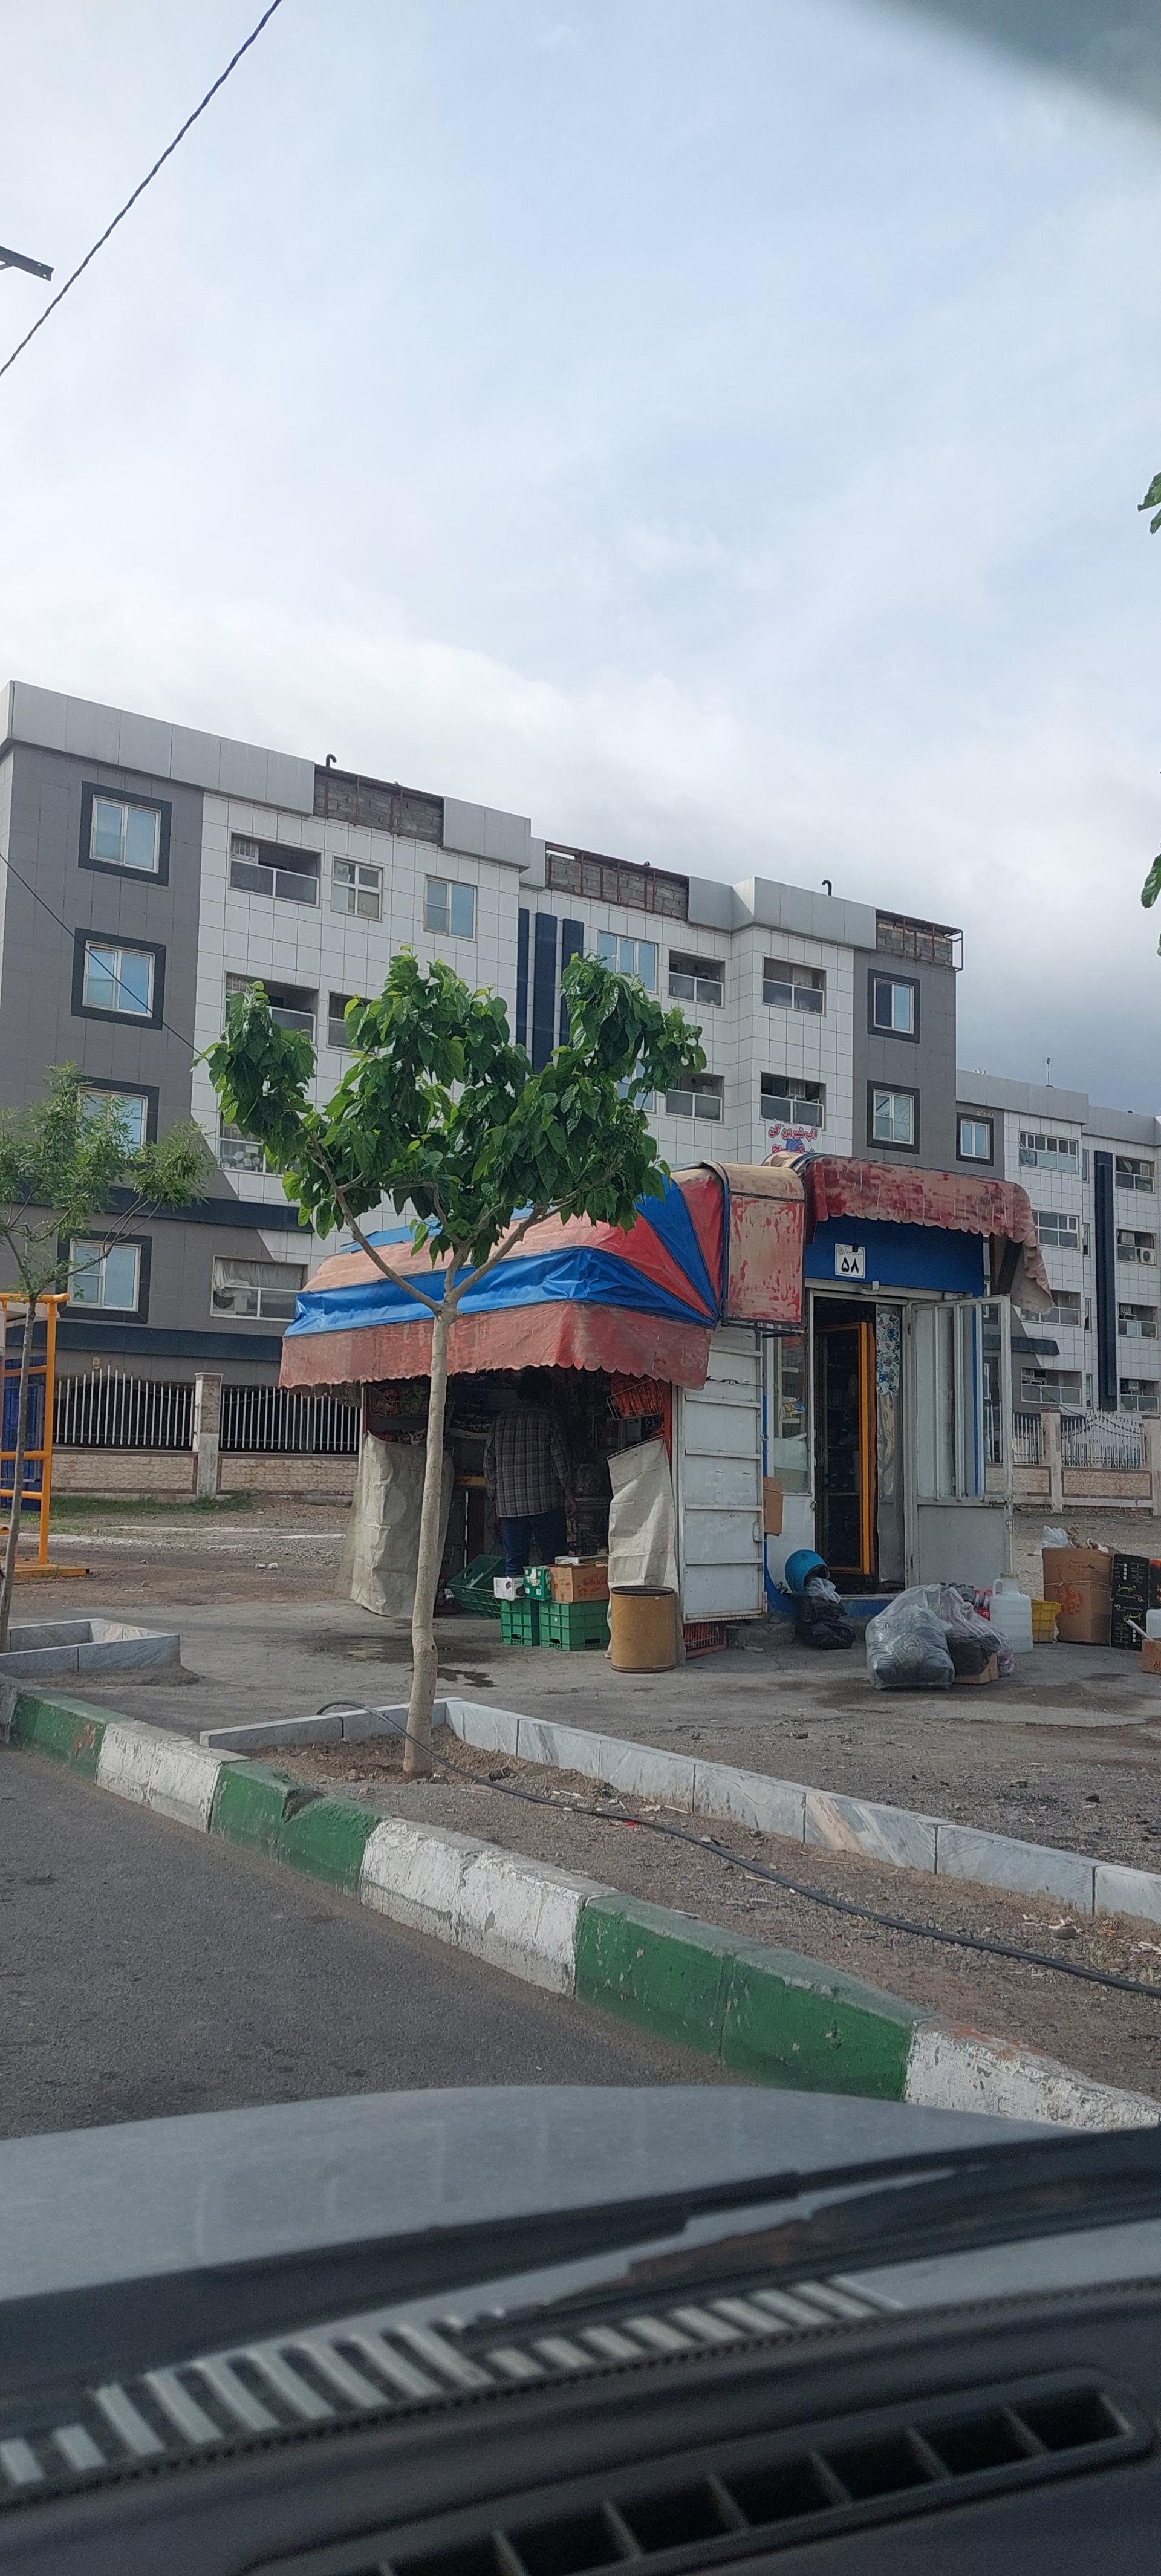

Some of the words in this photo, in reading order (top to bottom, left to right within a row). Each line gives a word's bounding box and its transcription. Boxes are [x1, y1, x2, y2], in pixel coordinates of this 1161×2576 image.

[769, 1124, 781, 1138] کن
[782, 1127, 804, 1140] شیرین
[805, 1127, 818, 1142] آب
[841, 1257, 859, 1274] ۵۸
